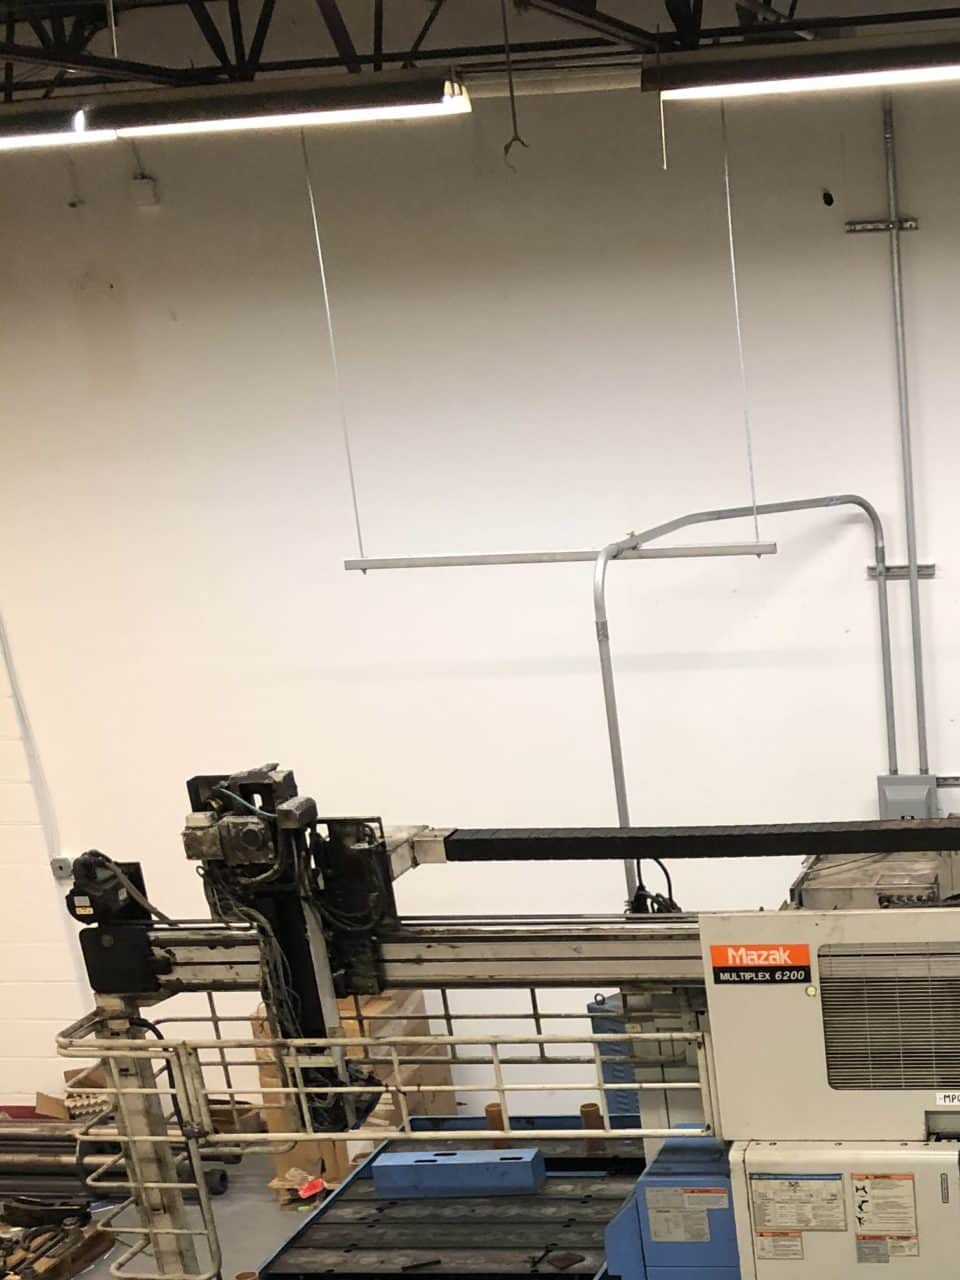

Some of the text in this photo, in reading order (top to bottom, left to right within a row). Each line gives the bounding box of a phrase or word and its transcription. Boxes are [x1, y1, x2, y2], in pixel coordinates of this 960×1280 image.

[727, 946, 792, 966] Mazak
[720, 970, 805, 981] MULTIPLEX 6200
